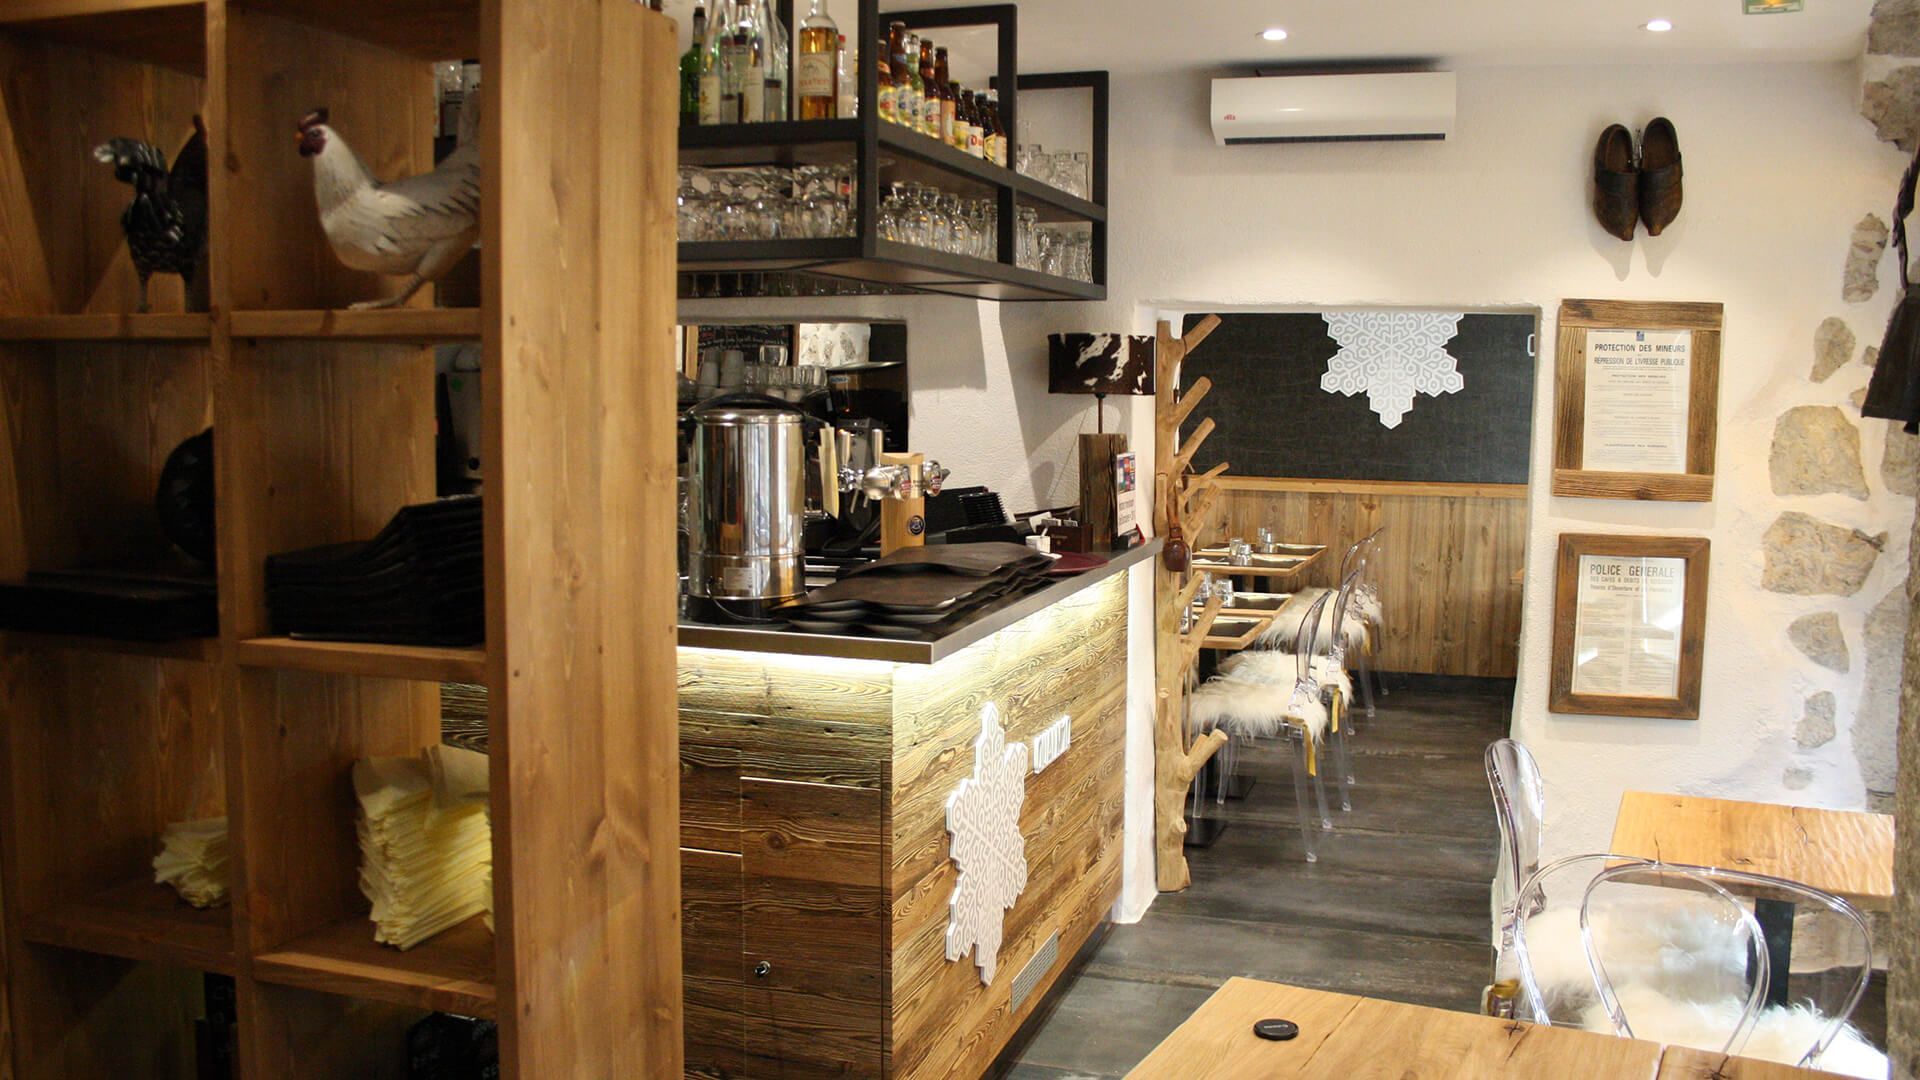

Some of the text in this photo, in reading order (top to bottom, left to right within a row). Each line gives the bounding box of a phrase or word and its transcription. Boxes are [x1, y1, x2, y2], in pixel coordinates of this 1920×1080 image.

[1594, 343, 1686, 353] PROTECTION DES MINEURS
[1626, 357, 1633, 365] DE
[1660, 358, 1685, 366] PUBLIQUE
[1590, 564, 1621, 576] POLICE
